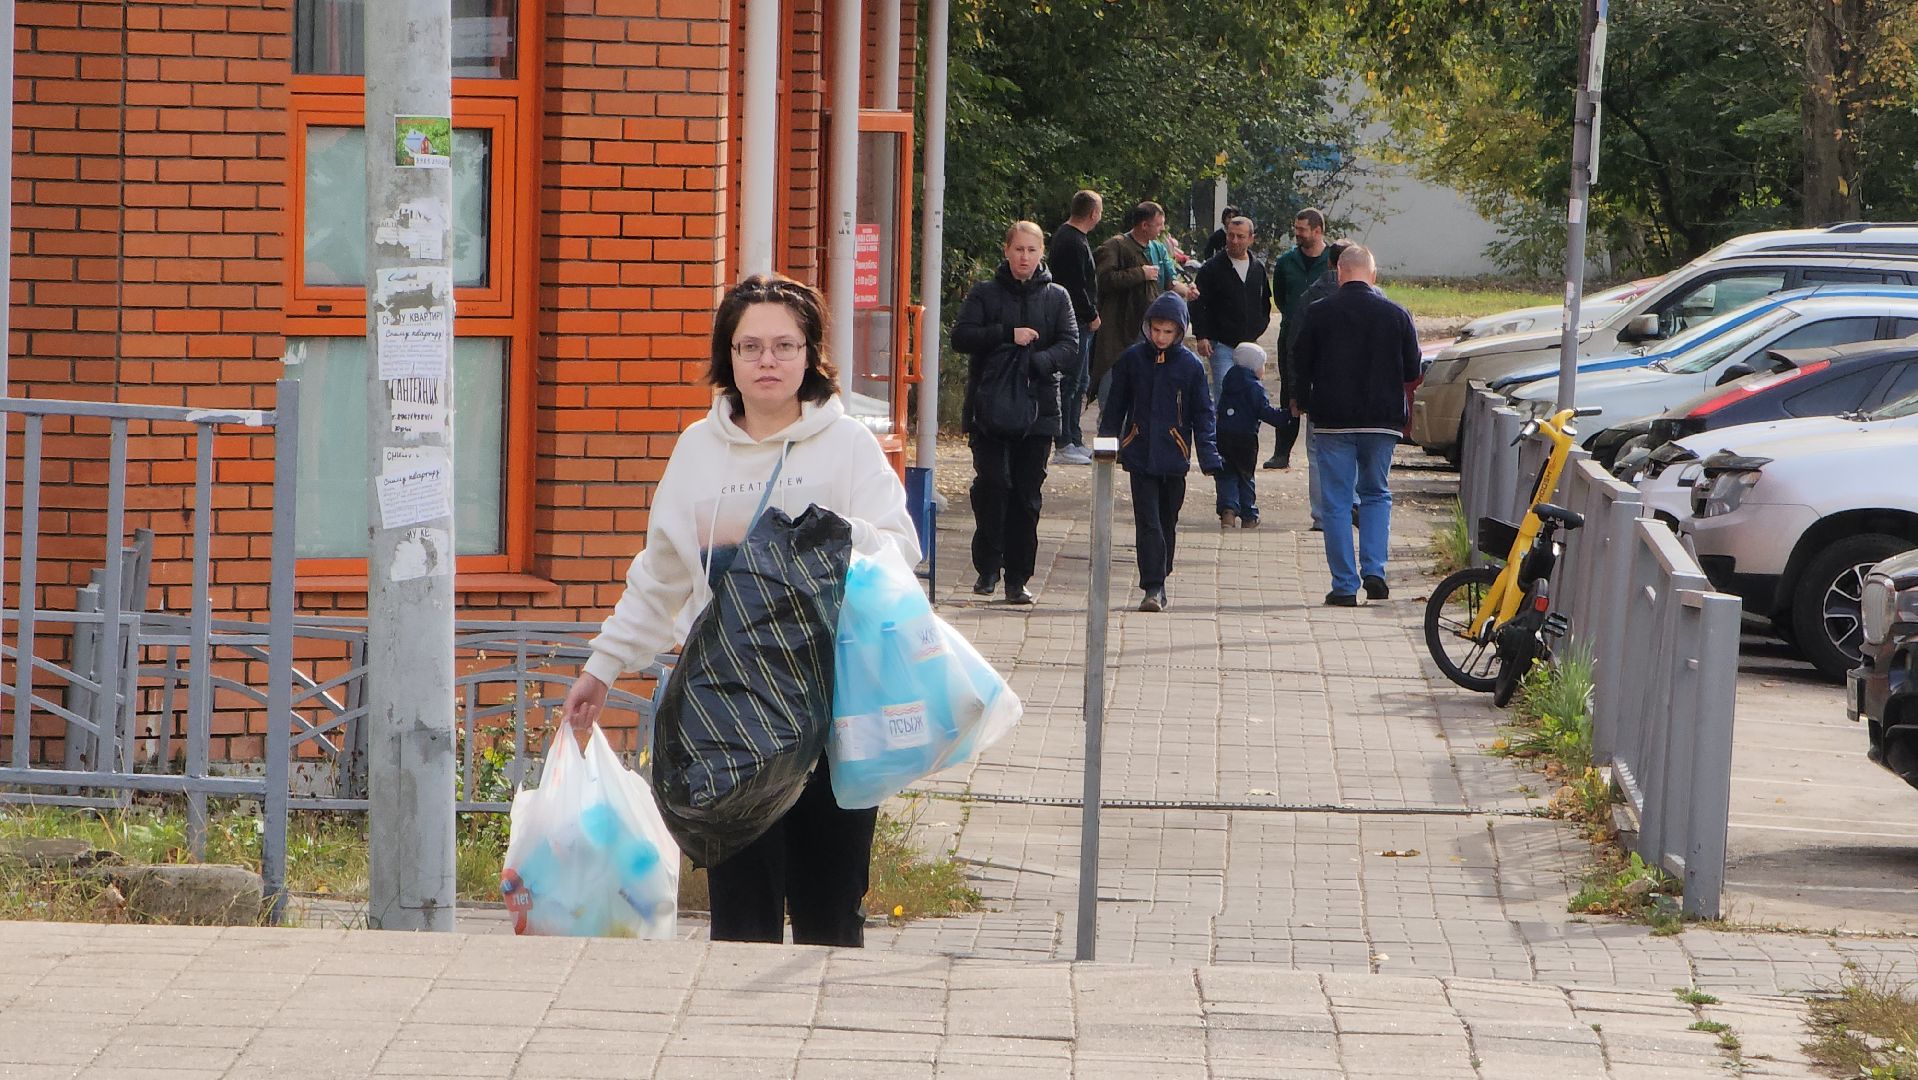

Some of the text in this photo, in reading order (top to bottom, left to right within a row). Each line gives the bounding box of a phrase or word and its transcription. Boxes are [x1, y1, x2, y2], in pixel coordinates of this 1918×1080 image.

[409, 311, 443, 323] КВАРТИРУ
[391, 377, 439, 406] САНТЕХНИК
[889, 715, 925, 736] ПСЫЖ
